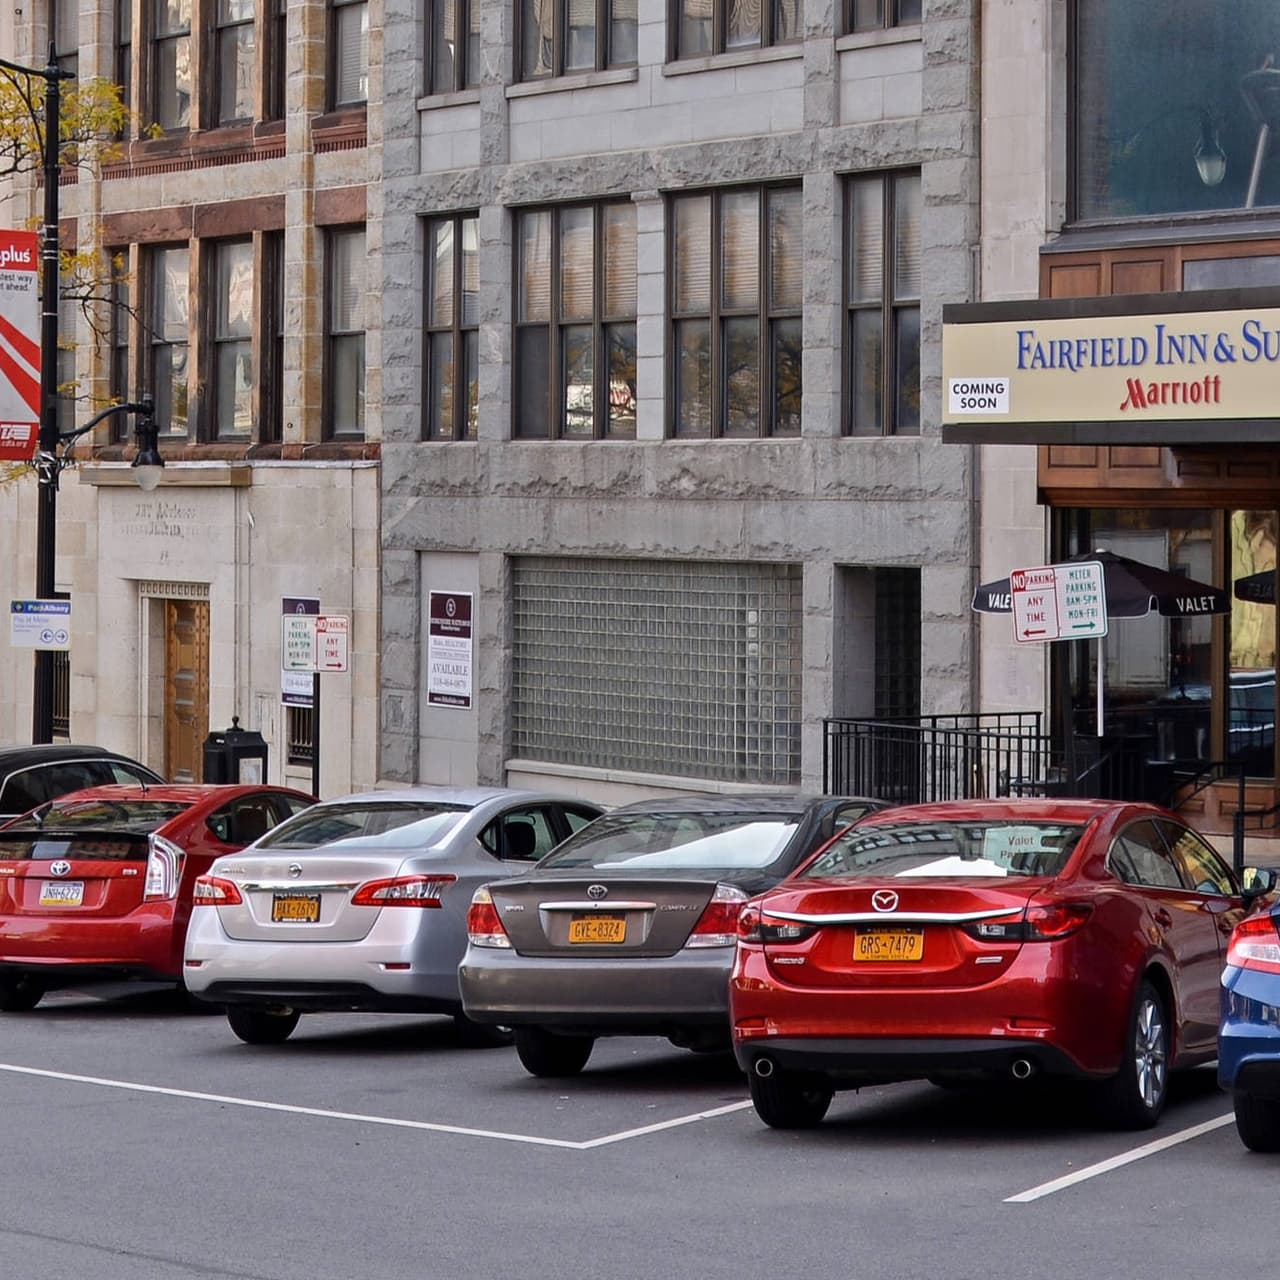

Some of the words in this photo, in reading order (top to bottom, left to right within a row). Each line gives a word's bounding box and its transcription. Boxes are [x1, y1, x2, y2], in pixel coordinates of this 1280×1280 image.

[18, 275, 33, 285] way
[1015, 329, 1149, 372] FAIRFIELD
[1154, 324, 1208, 366] INN
[1212, 332, 1237, 364] &
[952, 382, 1005, 396] COMING
[1120, 375, 1221, 411] Marriott
[960, 397, 998, 410] SOON
[1069, 569, 1091, 579] METER
[1012, 574, 1025, 589] NO
[1025, 573, 1055, 585] PARKING
[1065, 581, 1097, 593] PARKING
[988, 592, 1013, 609] VALE
[1027, 596, 1044, 607] ANY
[1176, 595, 1216, 613] VALET
[1026, 612, 1046, 623] TIME
[1068, 608, 1098, 620] MON-FRI
[326, 638, 338, 646] ANY
[325, 649, 339, 658] TIME
[432, 663, 468, 676] AVAILABLE
[1007, 835, 1034, 847] Valet
